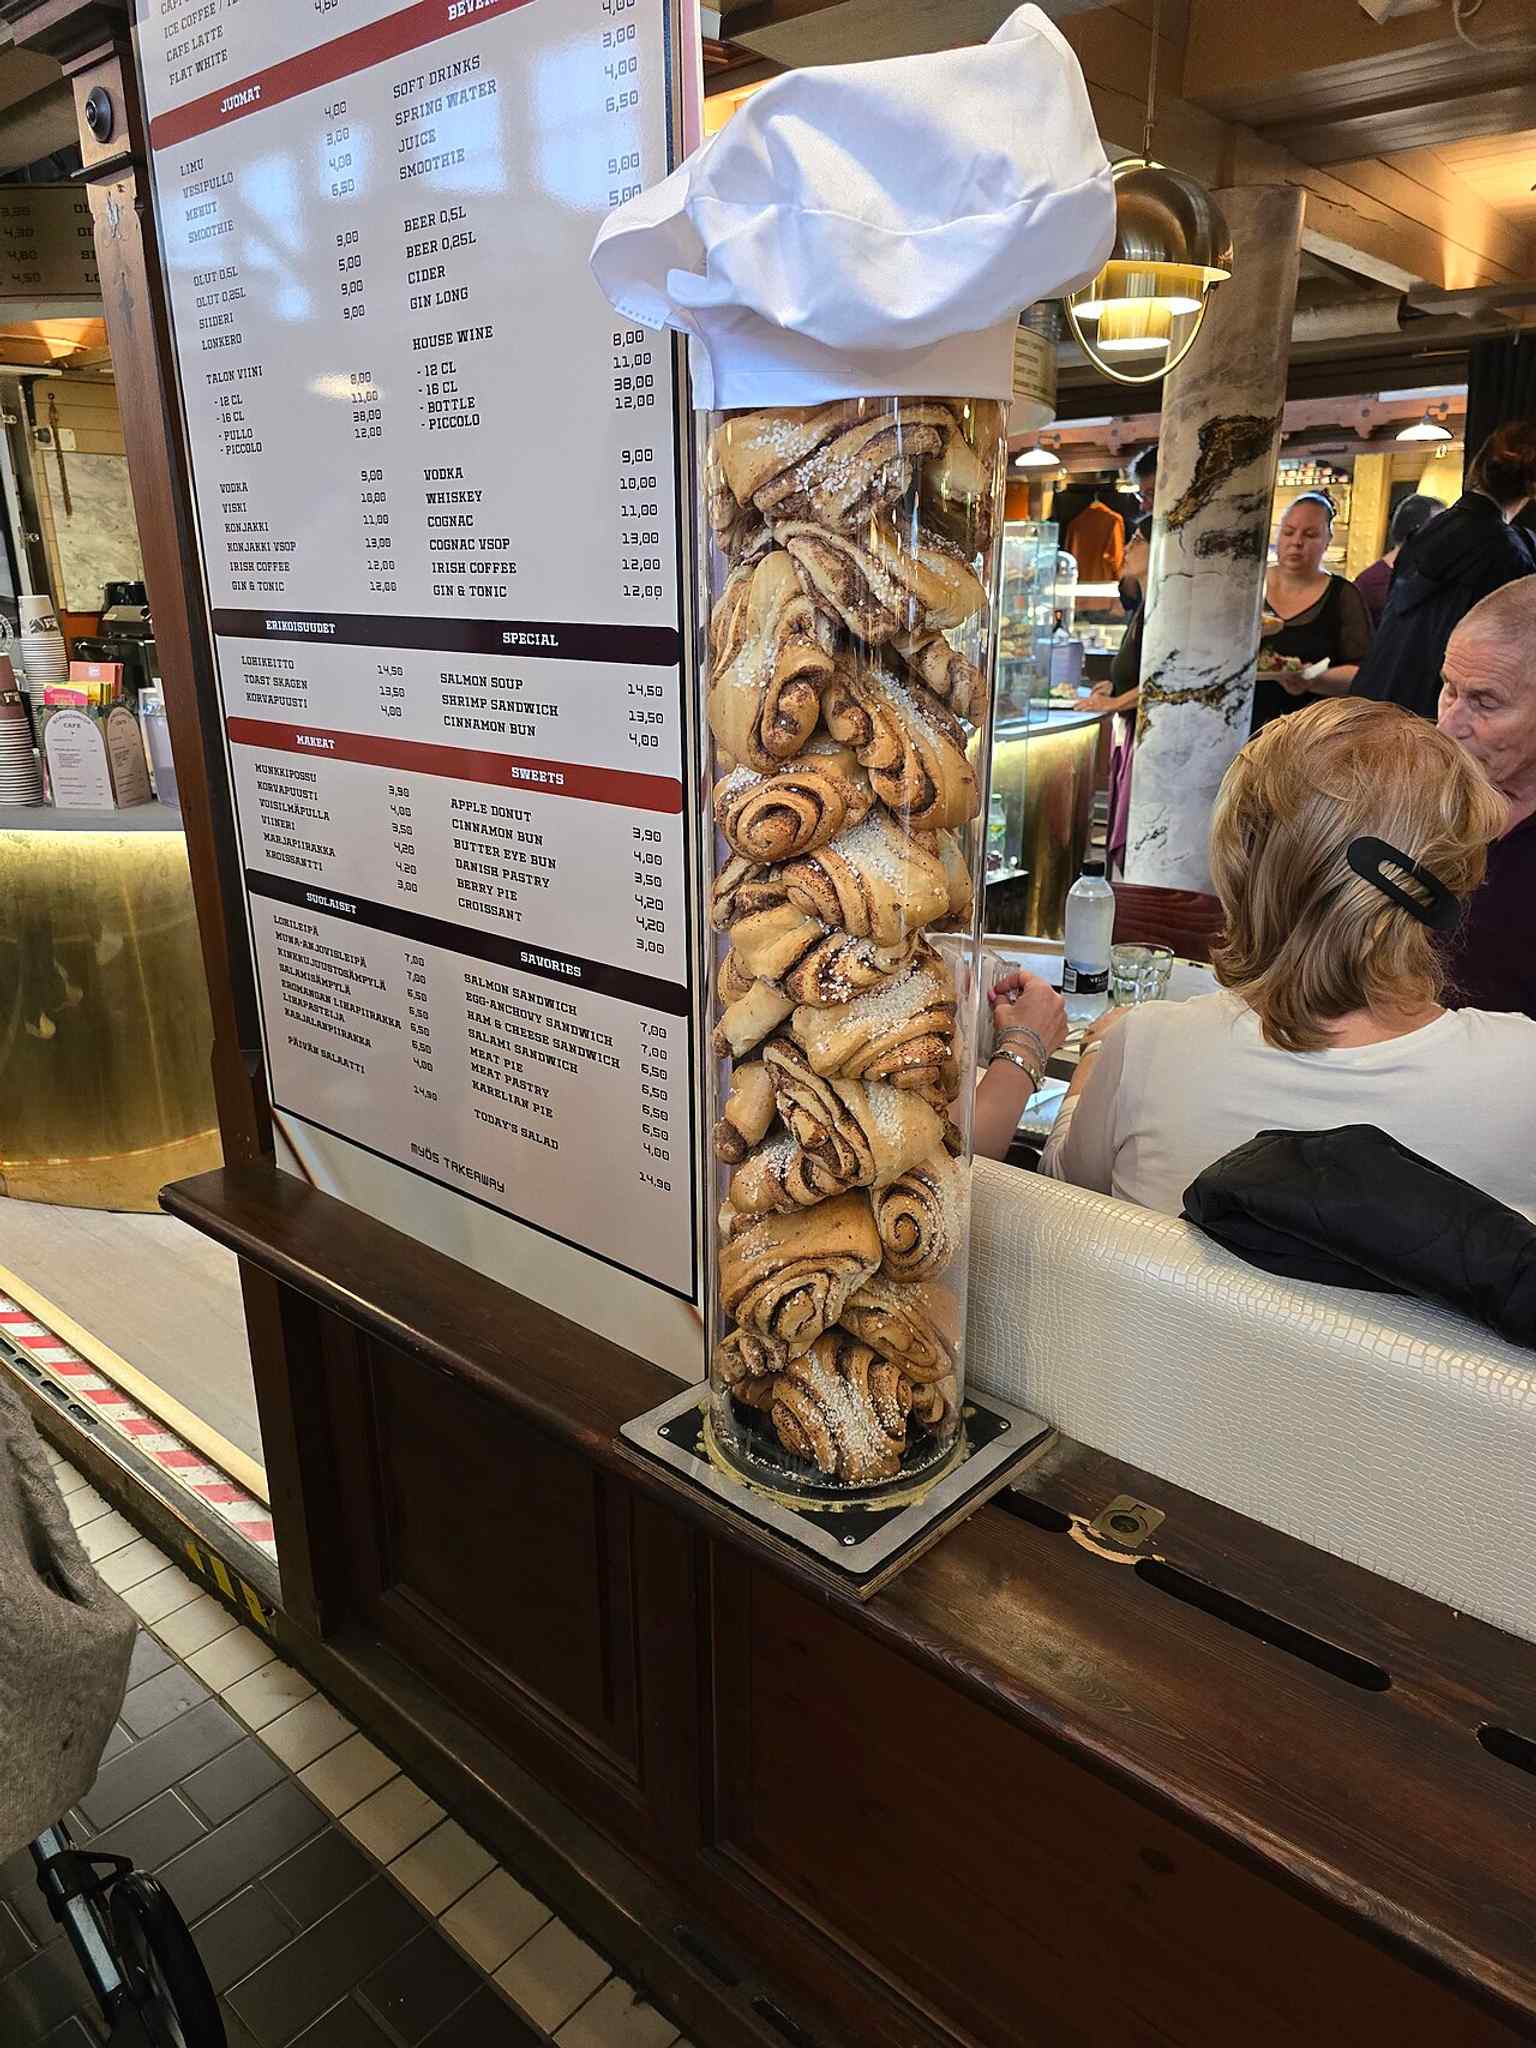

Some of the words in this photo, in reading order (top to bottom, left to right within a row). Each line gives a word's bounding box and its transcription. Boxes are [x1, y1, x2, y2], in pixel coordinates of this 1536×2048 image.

[603, 24, 636, 48] 3,00
[393, 75, 424, 98] SOFT
[429, 55, 481, 86] DRINKS
[395, 97, 443, 126] SPRING
[448, 79, 497, 109] WATER
[606, 90, 639, 113] 6,50
[399, 129, 436, 152] JUICE
[400, 148, 465, 180] SMOOTHIE
[404, 216, 436, 233] BEER
[440, 206, 467, 225] 0,5L
[406, 242, 439, 259] BEER
[442, 232, 477, 251] 0,25L
[408, 265, 446, 285] CIDER
[410, 296, 432, 310] GIN
[436, 287, 469, 305] LONG
[413, 334, 453, 351] HOUSE
[457, 326, 494, 344] WINE
[613, 330, 644, 348] 8,00
[425, 364, 438, 377] 12
[441, 362, 456, 375] CL
[613, 353, 651, 369] 11,00
[426, 383, 439, 396] 16
[442, 381, 458, 394] CL
[614, 375, 654, 392] 38,00
[427, 397, 475, 413] BOTTLE
[615, 394, 655, 410] 12,00
[429, 414, 480, 430] PICCOLO
[622, 449, 653, 465] 9,00
[424, 467, 464, 481] VODKA
[620, 477, 657, 491] 10,00
[426, 491, 482, 503] WHISKEY
[621, 504, 658, 518] 11,00
[428, 515, 473, 527] COGNAC
[430, 539, 475, 550] COGNAC
[478, 538, 510, 550] VSOP
[622, 532, 659, 546] 13,00
[432, 562, 466, 573] IRISH
[470, 562, 517, 574] COFFEE
[622, 560, 660, 572] 12,00
[433, 585, 454, 596] GIN
[457, 585, 465, 596] &
[469, 585, 507, 597] TONIC
[623, 585, 662, 598] 12,00
[502, 632, 559, 646] SPECIAL
[440, 673, 487, 686] SALMON
[491, 677, 523, 690] SOUP
[627, 684, 663, 697] 14,50
[442, 695, 487, 709] SHRIMP
[491, 700, 559, 717] SANDWICH
[444, 716, 505, 733] CINNAMON
[510, 724, 536, 736] BUN
[628, 711, 664, 724] 13,50
[629, 733, 659, 747] 4,00
[511, 767, 564, 785] SWEETS
[451, 798, 488, 814] APPLE
[491, 806, 532, 822] DONUT
[452, 819, 513, 840] CINNAMON
[517, 832, 543, 845] BUN
[633, 827, 662, 843] 3,90
[454, 838, 500, 858] BUTTER
[503, 849, 526, 863] EYE
[531, 854, 556, 869] BUN
[634, 851, 662, 866] 4,00
[455, 858, 498, 877] DANISH
[503, 869, 550, 888] PASTRY
[634, 872, 662, 888] 3,50
[457, 878, 494, 897] BERRY
[497, 887, 518, 901] PIE
[458, 898, 522, 923] CROISSANT
[635, 894, 664, 911] 4,20
[636, 915, 665, 933] 4,20
[636, 938, 665, 954] 3,00
[520, 952, 582, 977] SAVORIES
[464, 973, 509, 995] SALMON
[513, 988, 577, 1016] SANDWICH
[466, 992, 542, 1024] EGG-ANCHOVY
[545, 1017, 613, 1047] SANDWICH
[640, 1022, 667, 1039] 7,00
[467, 1010, 491, 1025] HAM
[494, 1018, 501, 1028] &
[505, 1023, 550, 1045] CHEESE
[552, 1039, 620, 1069] SANDWICH
[468, 1028, 511, 1050] SALAMI
[514, 1045, 579, 1074] SANDWICH
[470, 1046, 500, 1066] MEAT
[504, 1059, 523, 1073] PIE
[640, 1044, 667, 1060] 7,00
[641, 1063, 667, 1080] 6,50
[471, 1063, 501, 1080] MEAT
[505, 1074, 550, 1099] PASTRY
[472, 1080, 529, 1109] KARELIAN
[533, 1103, 553, 1118] PIE
[641, 1084, 668, 1101] 6,50
[642, 1104, 668, 1121] 6,50
[474, 1109, 518, 1134] TODAY'S
[521, 1126, 559, 1150] SALAD
[642, 1124, 669, 1141] 6,50
[642, 1142, 670, 1161] 4,00
[411, 1142, 440, 1164] MYÖS
[443, 1157, 505, 1193] TAKEAWAY
[639, 1171, 671, 1191] 14,90
